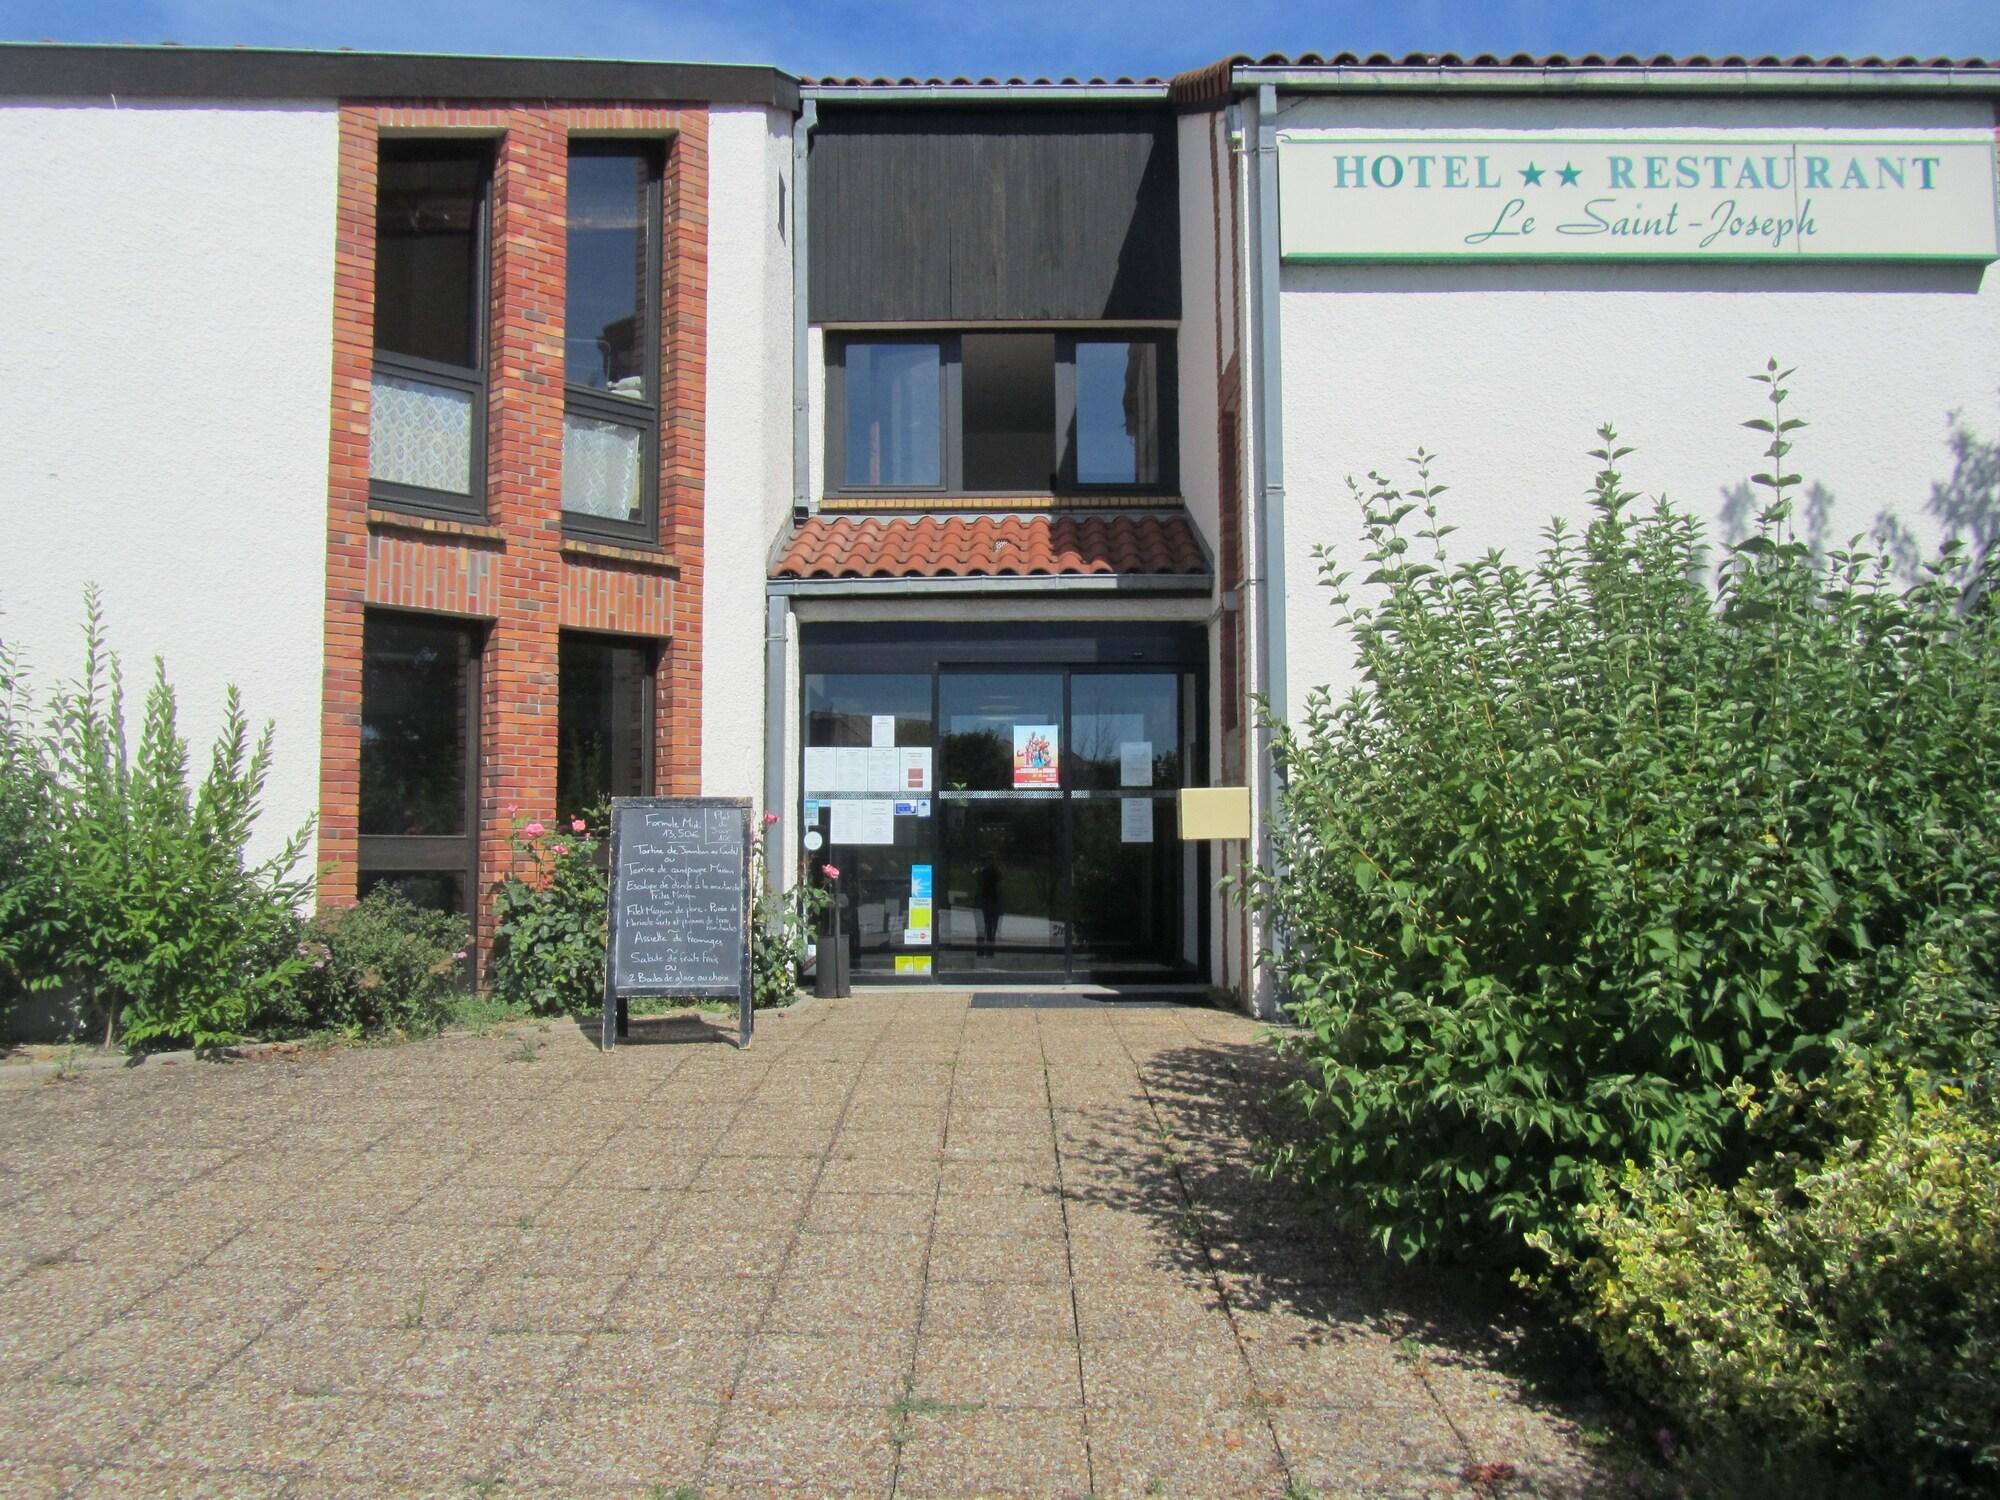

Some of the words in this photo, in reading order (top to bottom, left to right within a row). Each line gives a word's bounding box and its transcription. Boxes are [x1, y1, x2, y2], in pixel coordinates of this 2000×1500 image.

[1333, 155, 1501, 188] HOTEL
[1608, 156, 1940, 190] RESTAURANT
[1464, 198, 1536, 245] Le
[645, 813, 680, 828] Formule
[633, 844, 664, 855] Tartine
[667, 845, 678, 855] de
[624, 861, 656, 875] Terrine
[657, 864, 667, 873] de
[660, 880, 669, 890] de
[675, 906, 685, 914] de
[630, 951, 662, 963] Salade
[667, 954, 677, 963] de
[629, 973, 636, 983] 2
[664, 973, 673, 982] de
